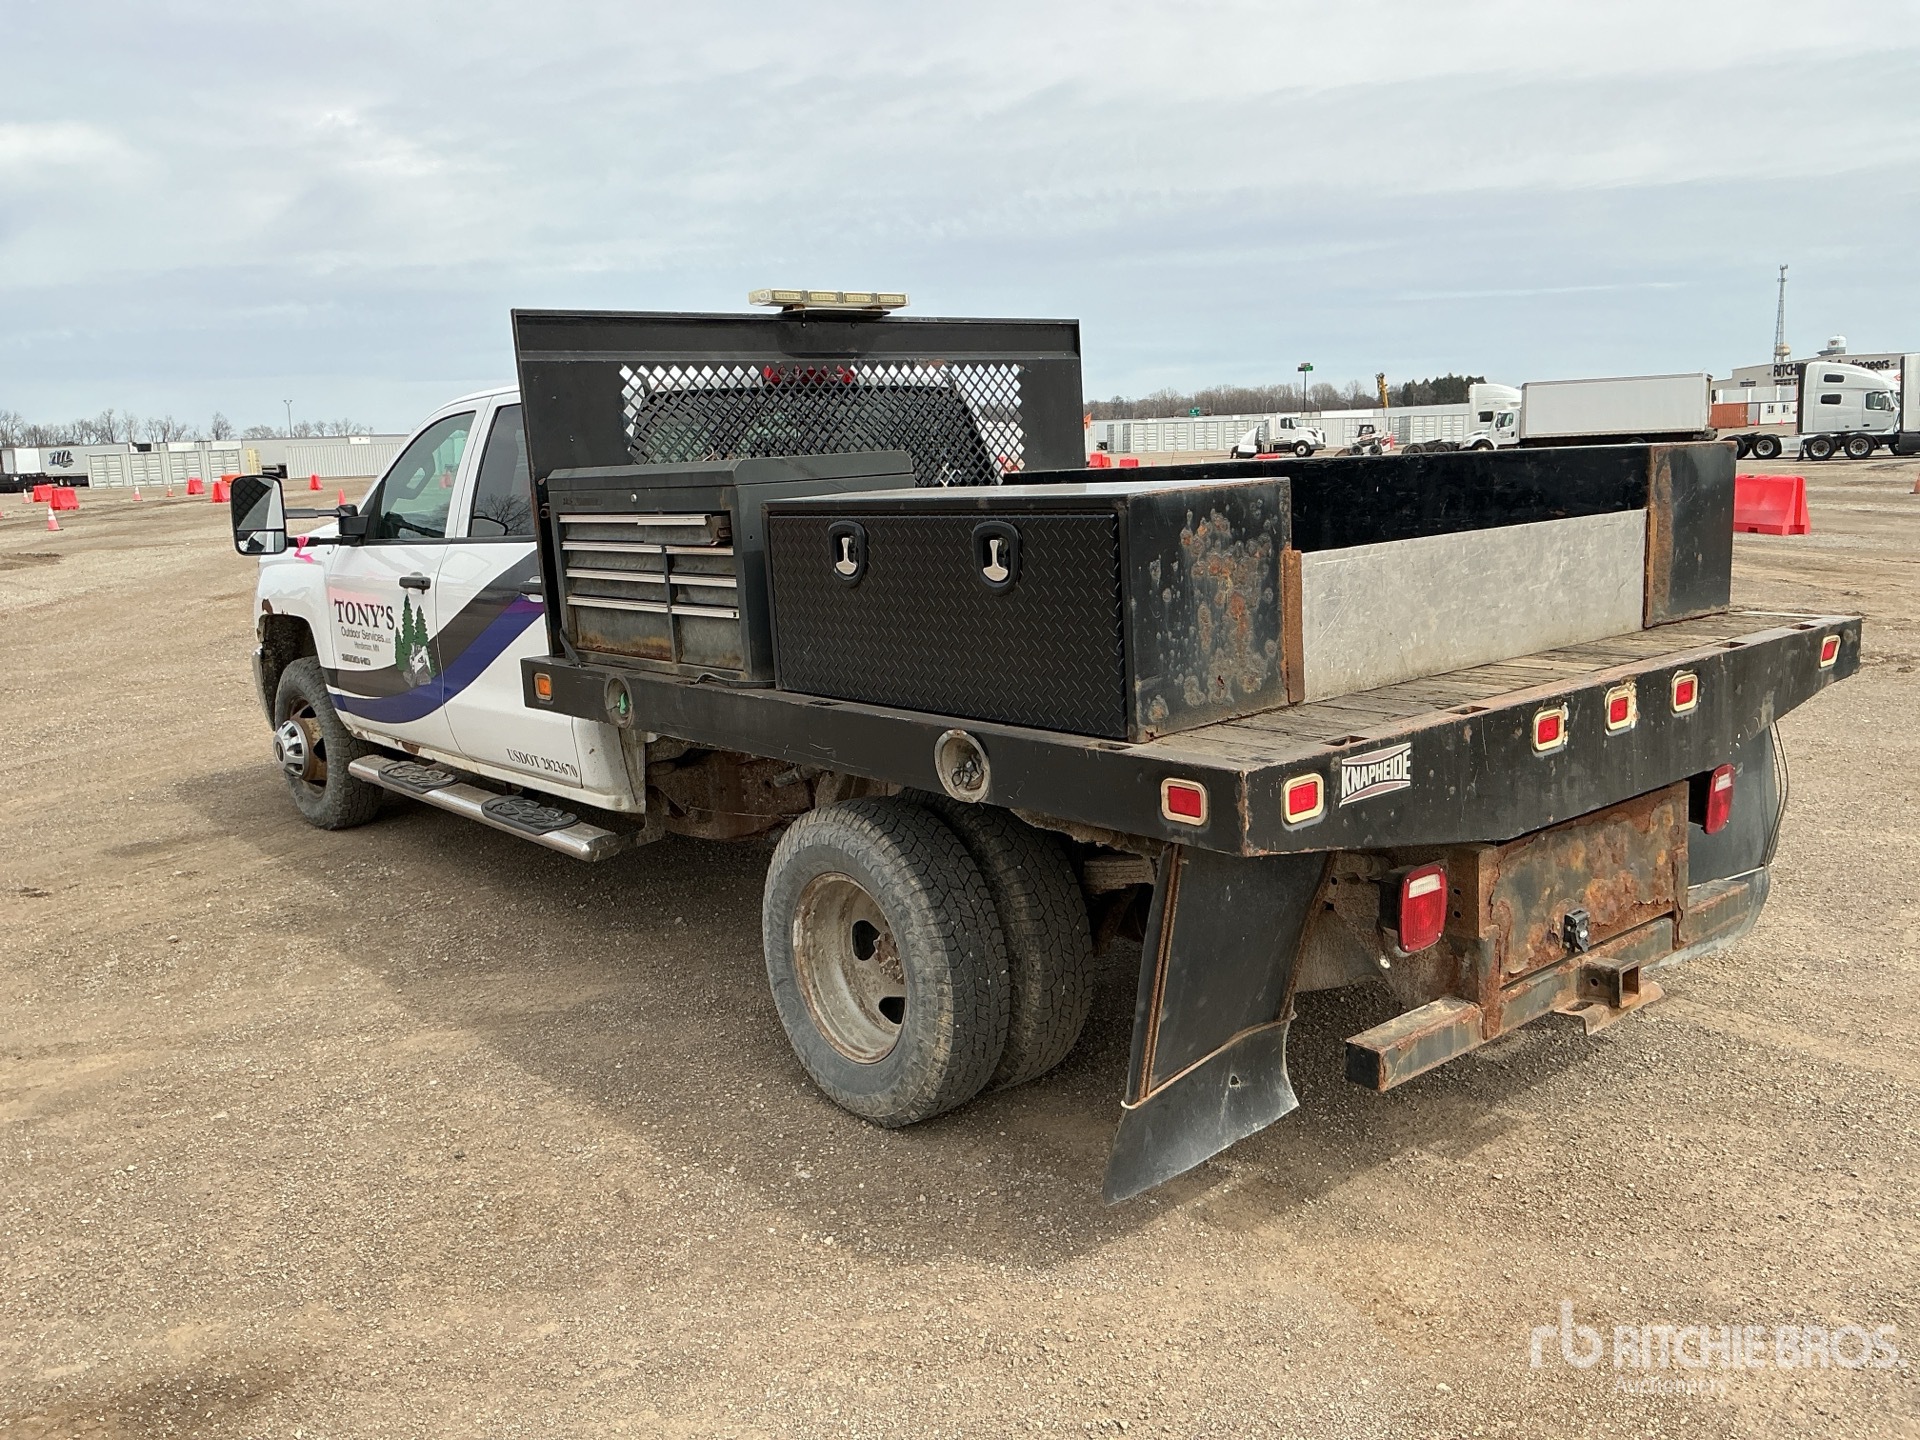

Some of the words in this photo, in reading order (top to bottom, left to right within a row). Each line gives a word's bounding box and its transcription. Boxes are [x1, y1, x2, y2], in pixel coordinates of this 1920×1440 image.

[1773, 362, 1799, 378] RITCH
[334, 598, 395, 630] TONY'S
[341, 626, 360, 638] Outdoor
[361, 629, 384, 643] Services
[506, 748, 540, 768] USDOT
[541, 757, 578, 778] 2823670
[1341, 748, 1411, 799] KNAPHEIDE
